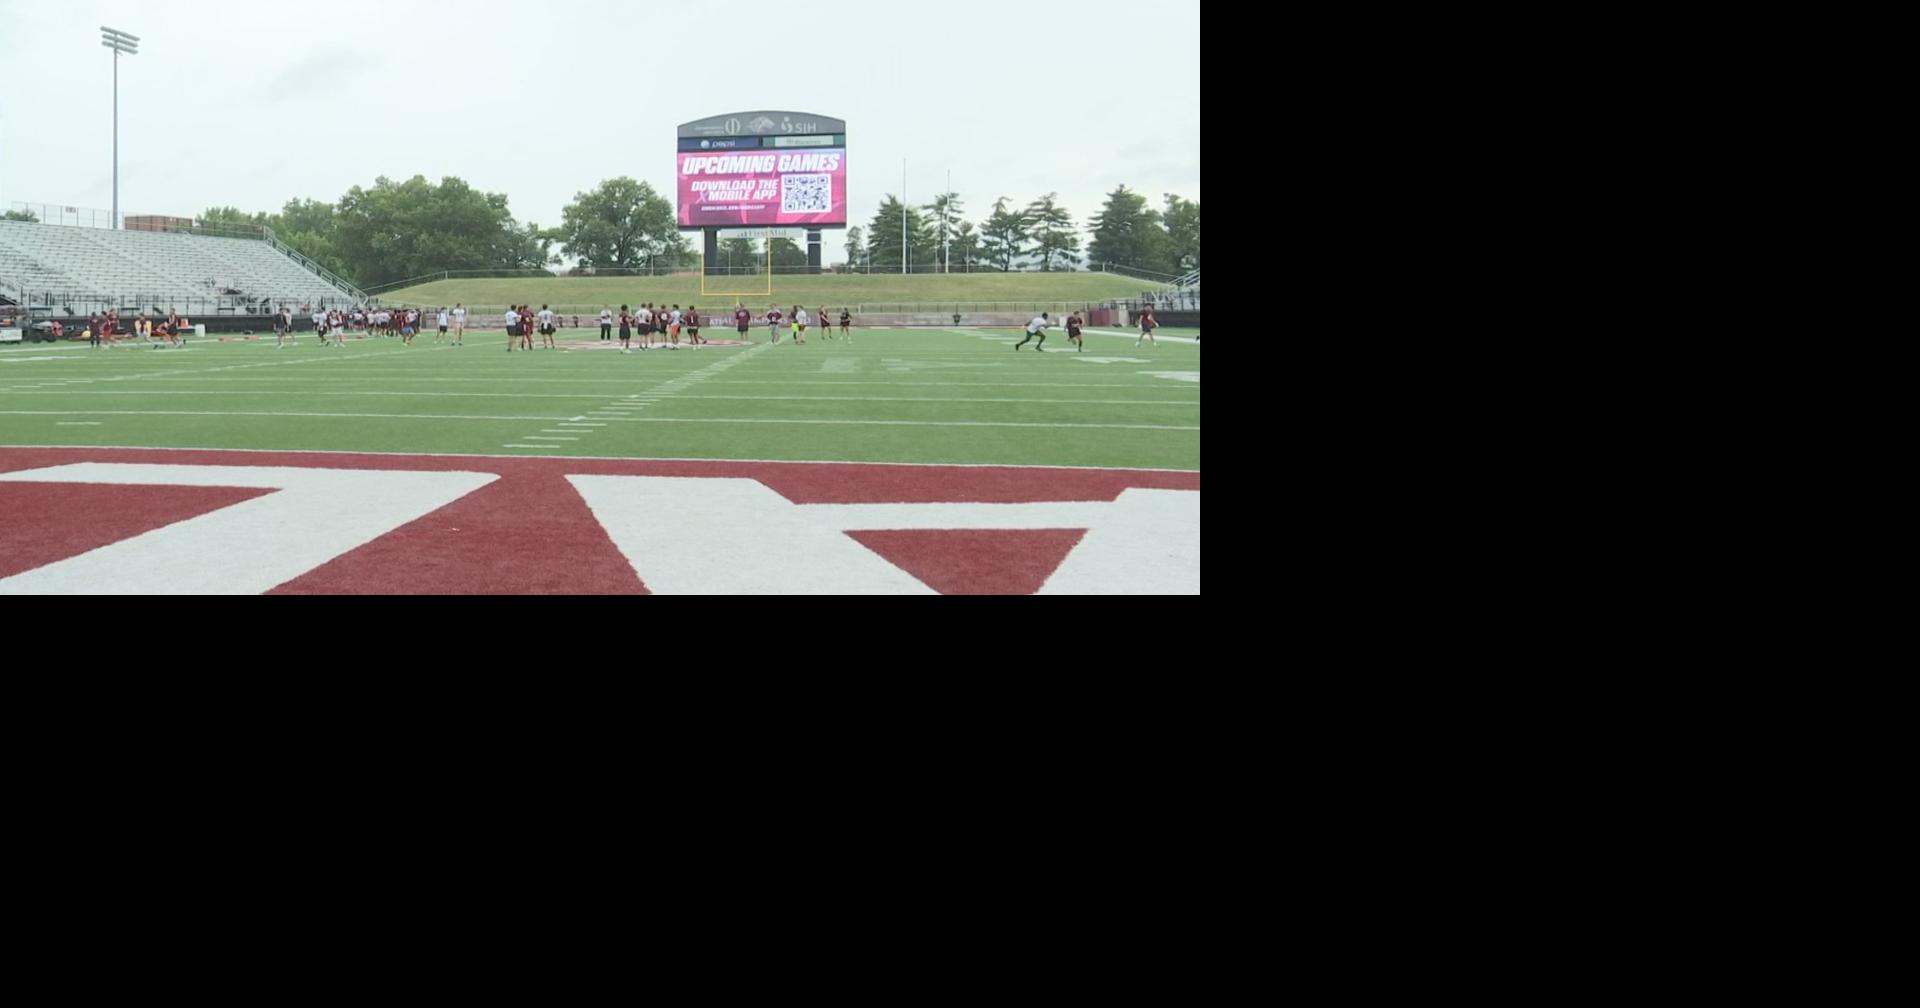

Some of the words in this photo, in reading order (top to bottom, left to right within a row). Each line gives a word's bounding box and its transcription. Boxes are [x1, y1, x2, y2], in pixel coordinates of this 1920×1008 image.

[795, 120, 817, 134] SIH
[681, 155, 776, 176] UPCOMING
[777, 153, 840, 172] GAMES
[691, 180, 756, 192] DOWNLOAD
[758, 178, 779, 189] THE
[708, 190, 750, 201] MOBILE
[752, 189, 777, 200] APP
